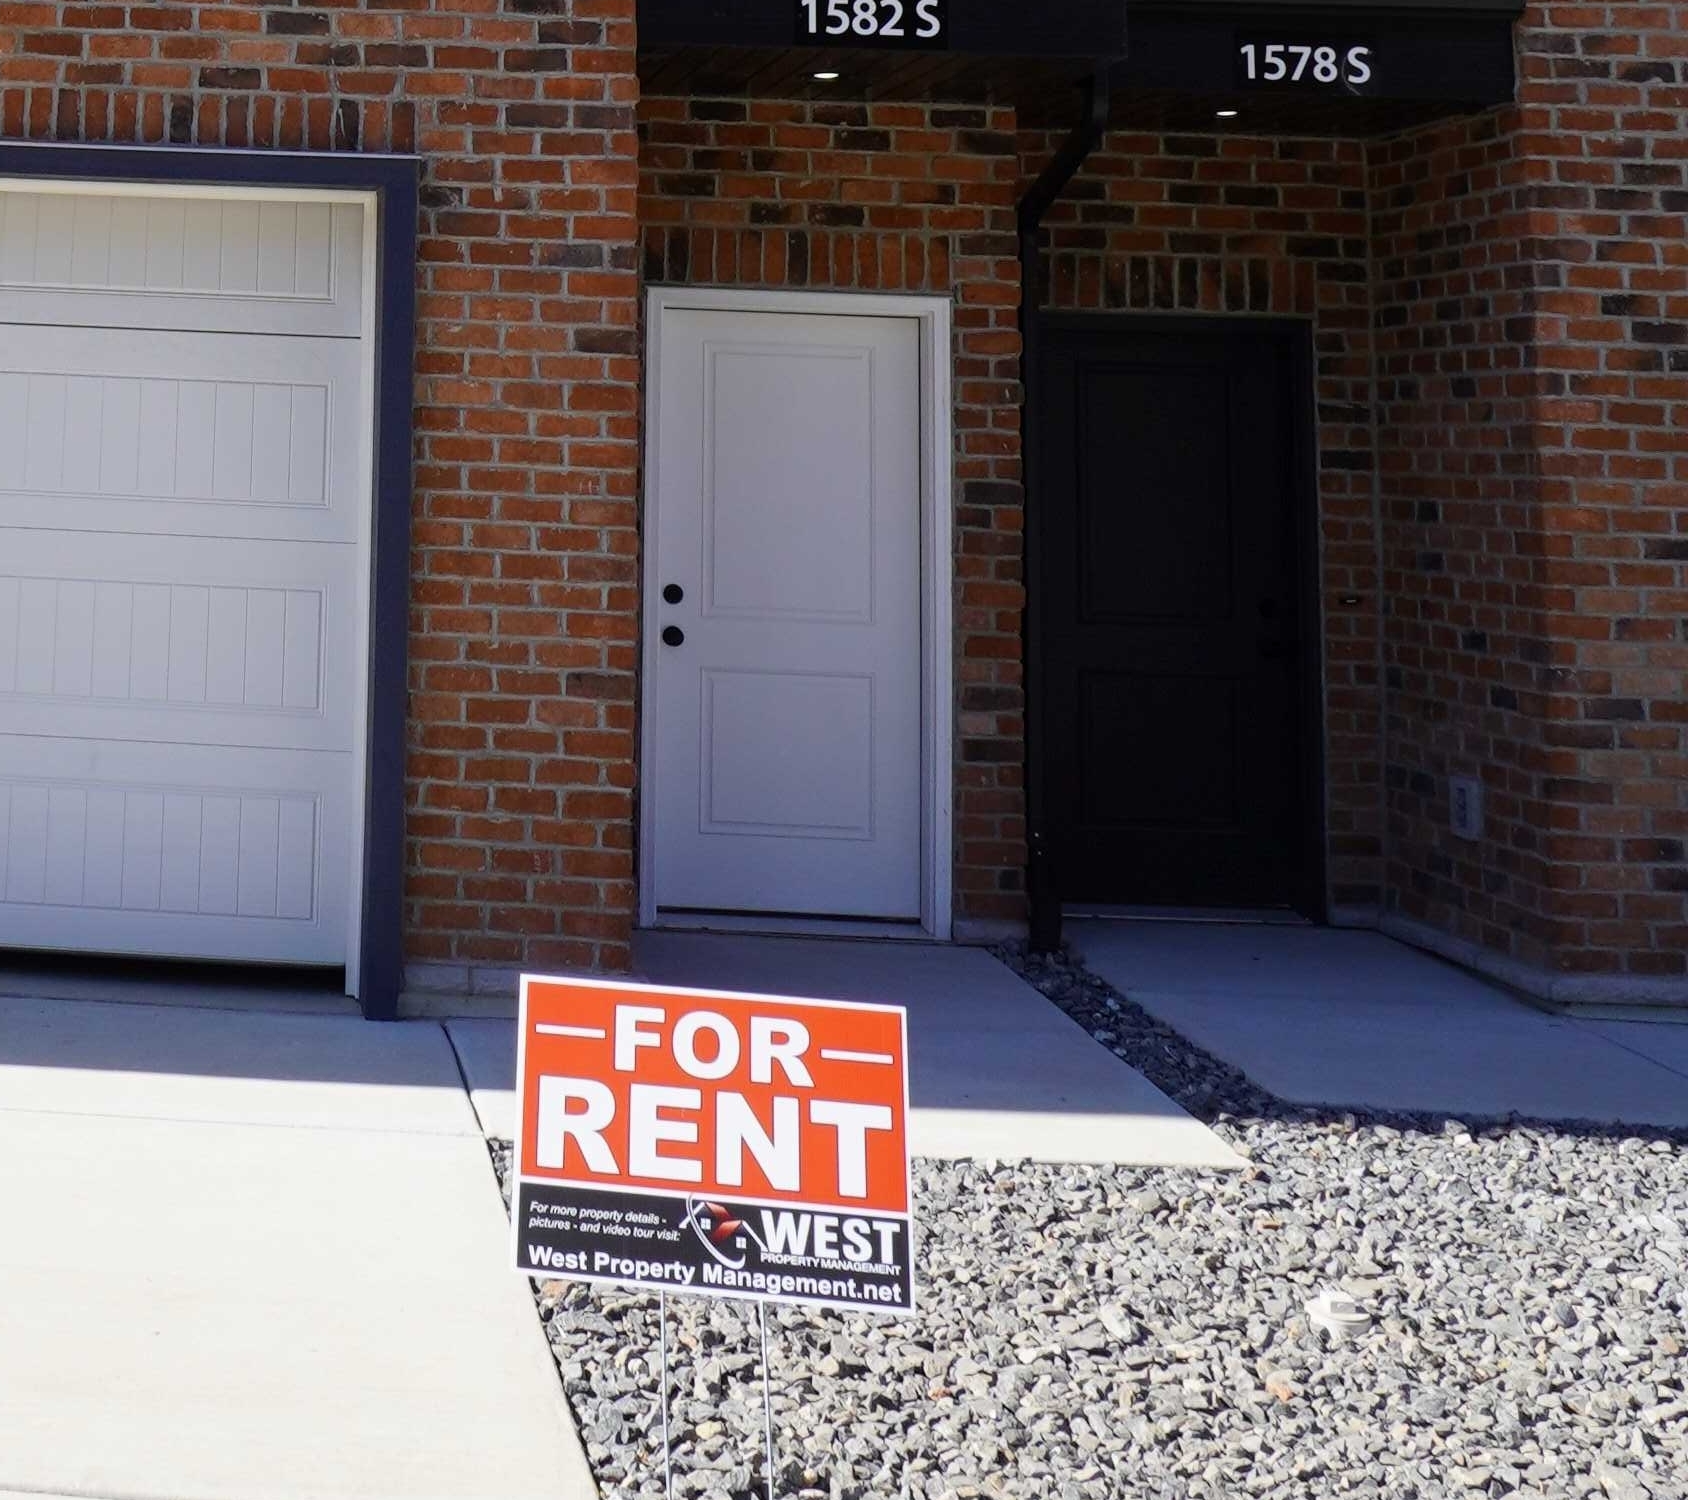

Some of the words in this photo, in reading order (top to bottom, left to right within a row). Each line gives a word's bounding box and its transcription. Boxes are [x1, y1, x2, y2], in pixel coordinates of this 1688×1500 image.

[1240, 43, 1338, 83] 1578
[1346, 46, 1371, 84] S
[613, 1003, 815, 1088] FOR
[535, 1074, 893, 1199] RENT
[528, 1216, 571, 1231] pictures
[579, 1221, 602, 1234] and
[602, 1222, 631, 1237] video
[632, 1226, 656, 1239] tour
[656, 1229, 681, 1242] visit:
[529, 1200, 550, 1214] For
[550, 1205, 577, 1217] more
[579, 1208, 623, 1224] property
[624, 1210, 660, 1226] details
[760, 1209, 901, 1265] WEST
[528, 1243, 588, 1271] West
[593, 1251, 696, 1285] Property
[702, 1262, 902, 1303] Management.net
[760, 1252, 820, 1268] PROPERTY
[820, 1259, 902, 1277] MANAGEMENT
